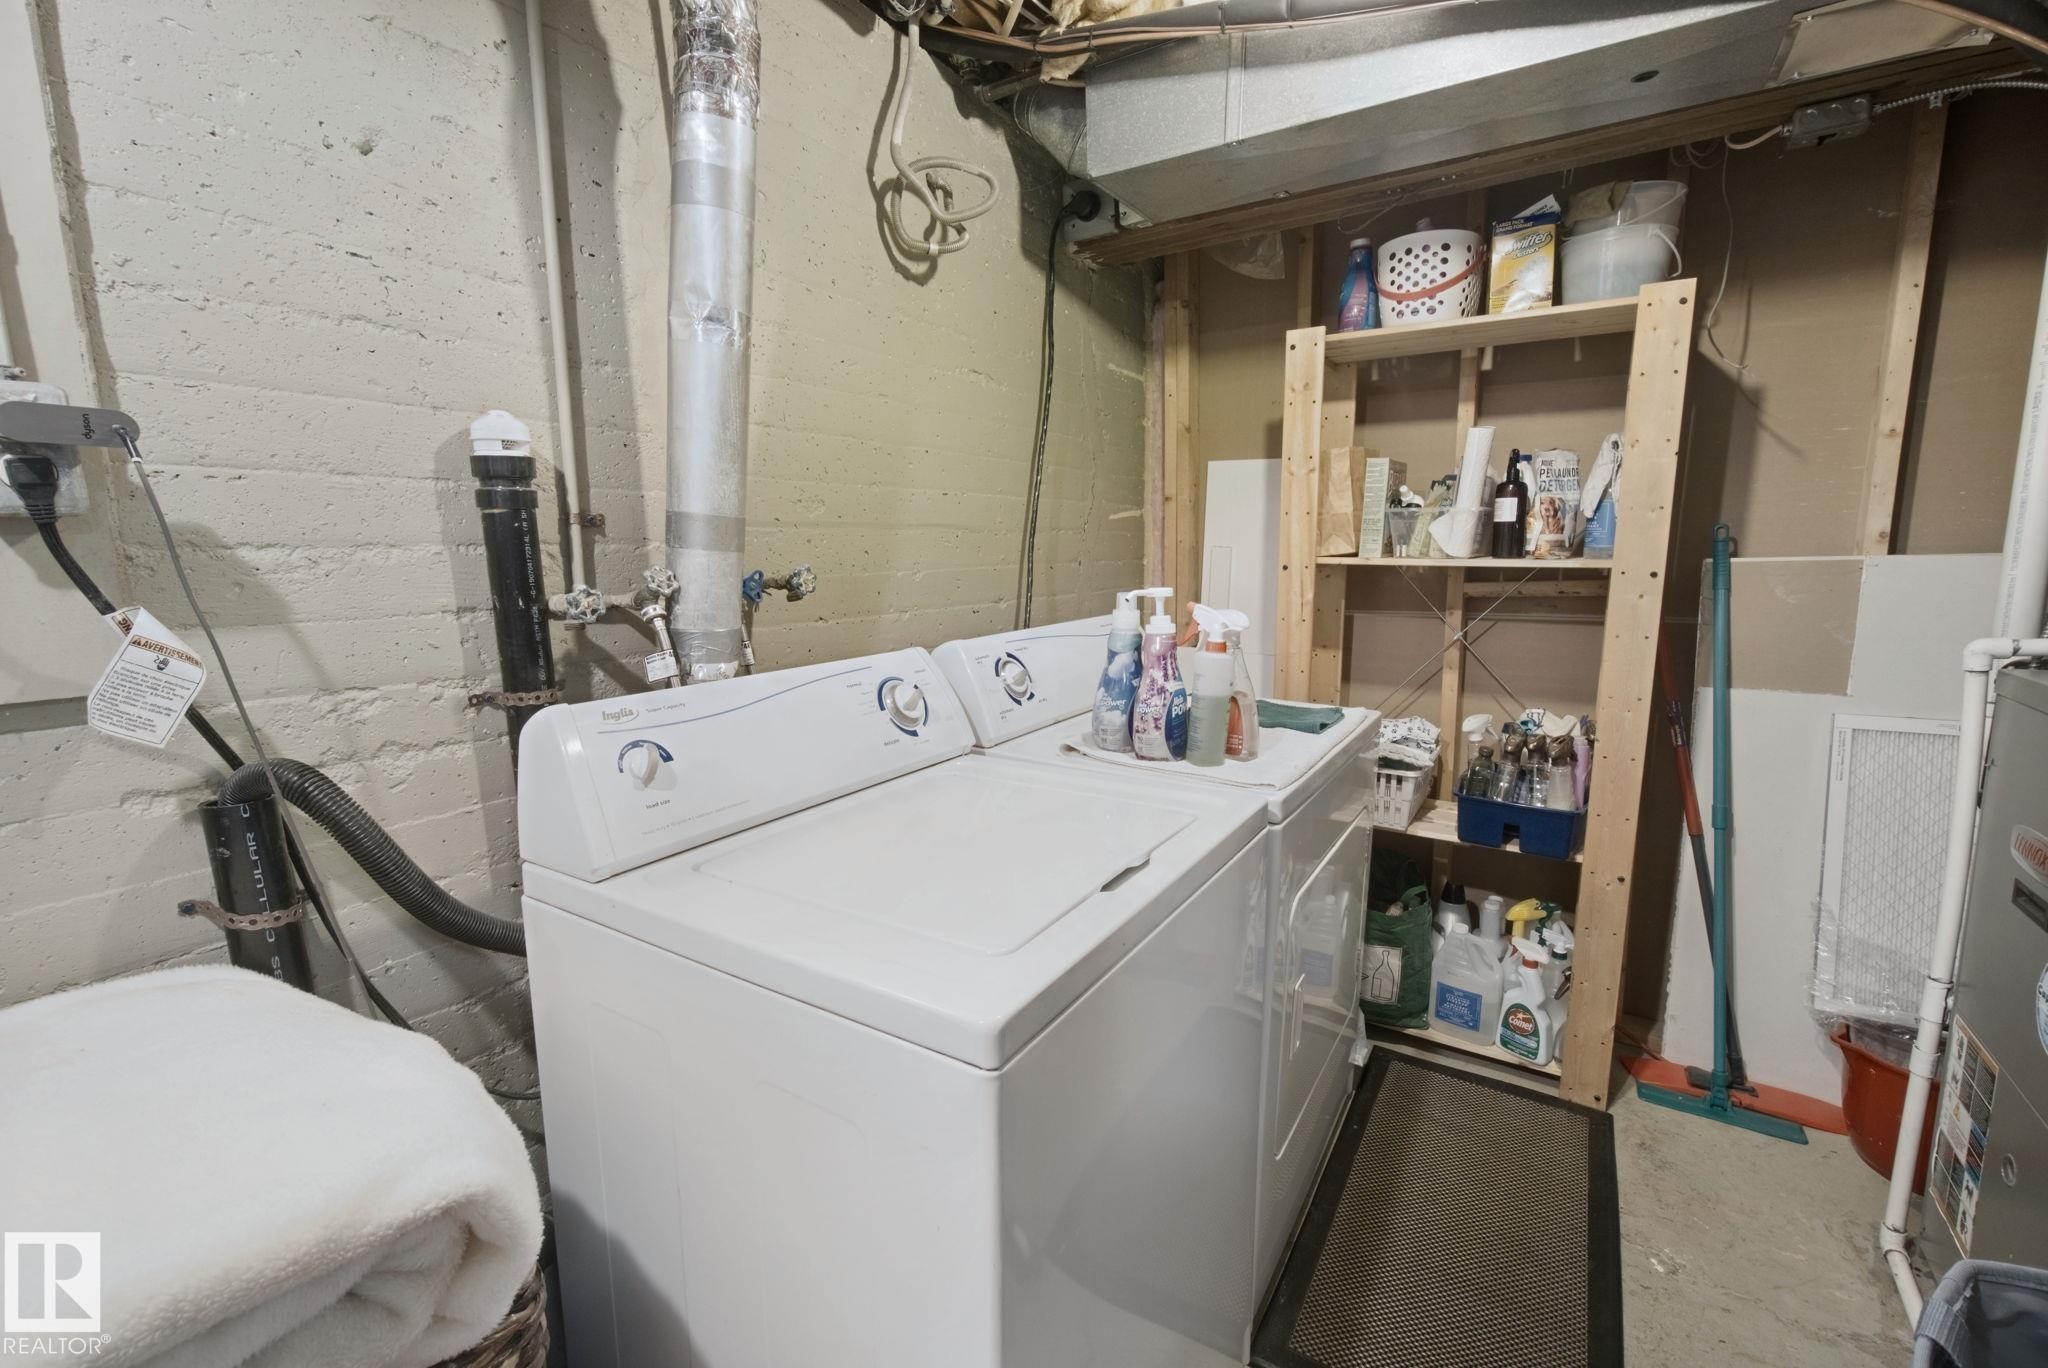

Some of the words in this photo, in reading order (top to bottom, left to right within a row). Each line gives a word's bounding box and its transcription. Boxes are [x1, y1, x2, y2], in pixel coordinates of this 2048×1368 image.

[82, 413, 95, 439] dyson
[1539, 479, 1580, 492] DETERGEN
[602, 707, 635, 722] Inglis
[246, 831, 275, 943] CLLULAR
[1508, 1015, 1533, 1031] Comet
